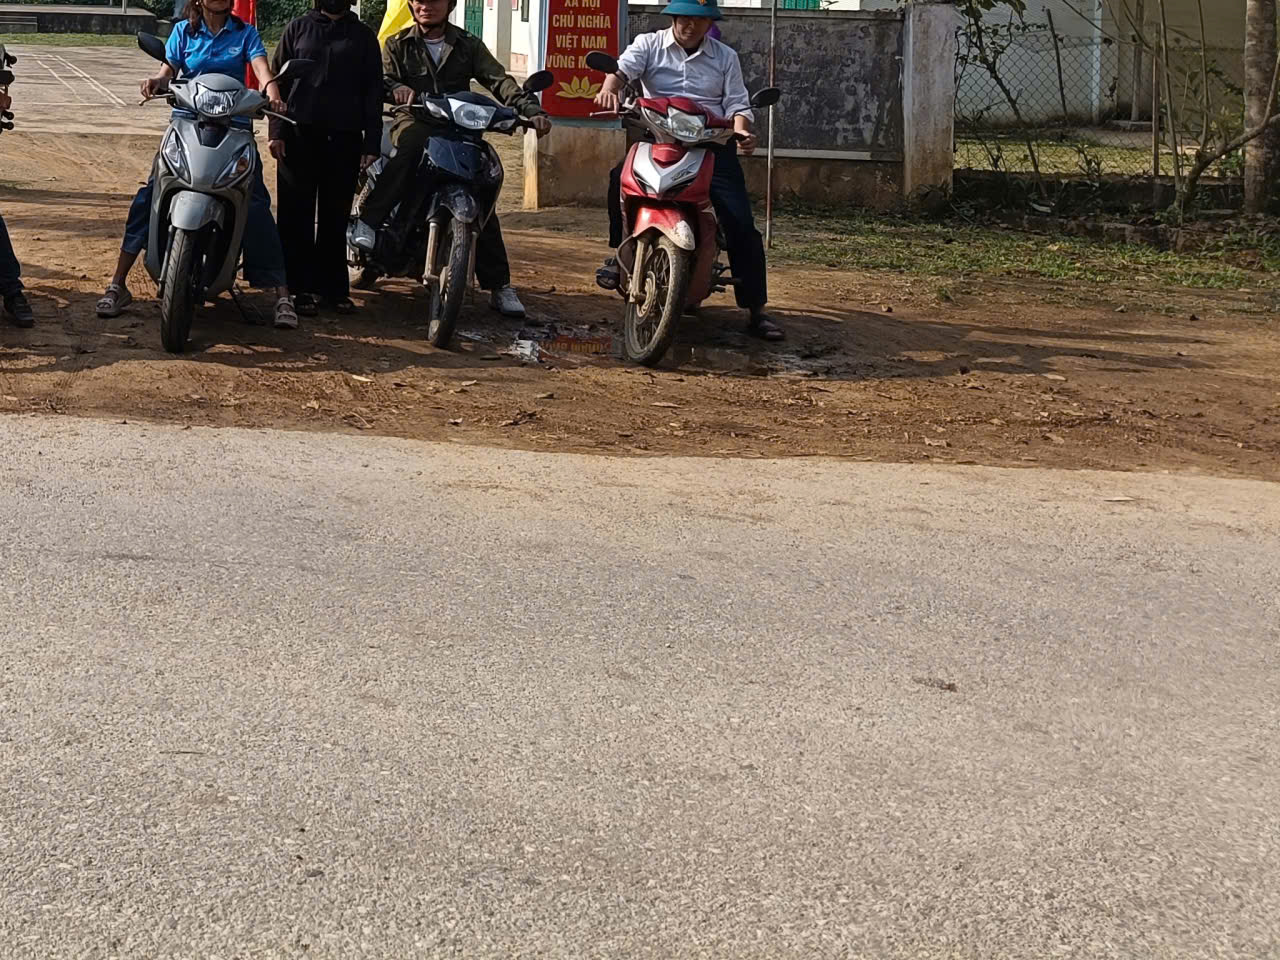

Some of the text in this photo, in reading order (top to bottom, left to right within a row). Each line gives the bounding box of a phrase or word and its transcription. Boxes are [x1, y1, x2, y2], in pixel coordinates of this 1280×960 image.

[552, 10, 611, 29] CHỦ NGHĨA
[555, 32, 607, 51] VIỆT NAM
[546, 52, 575, 69] VỮNG
